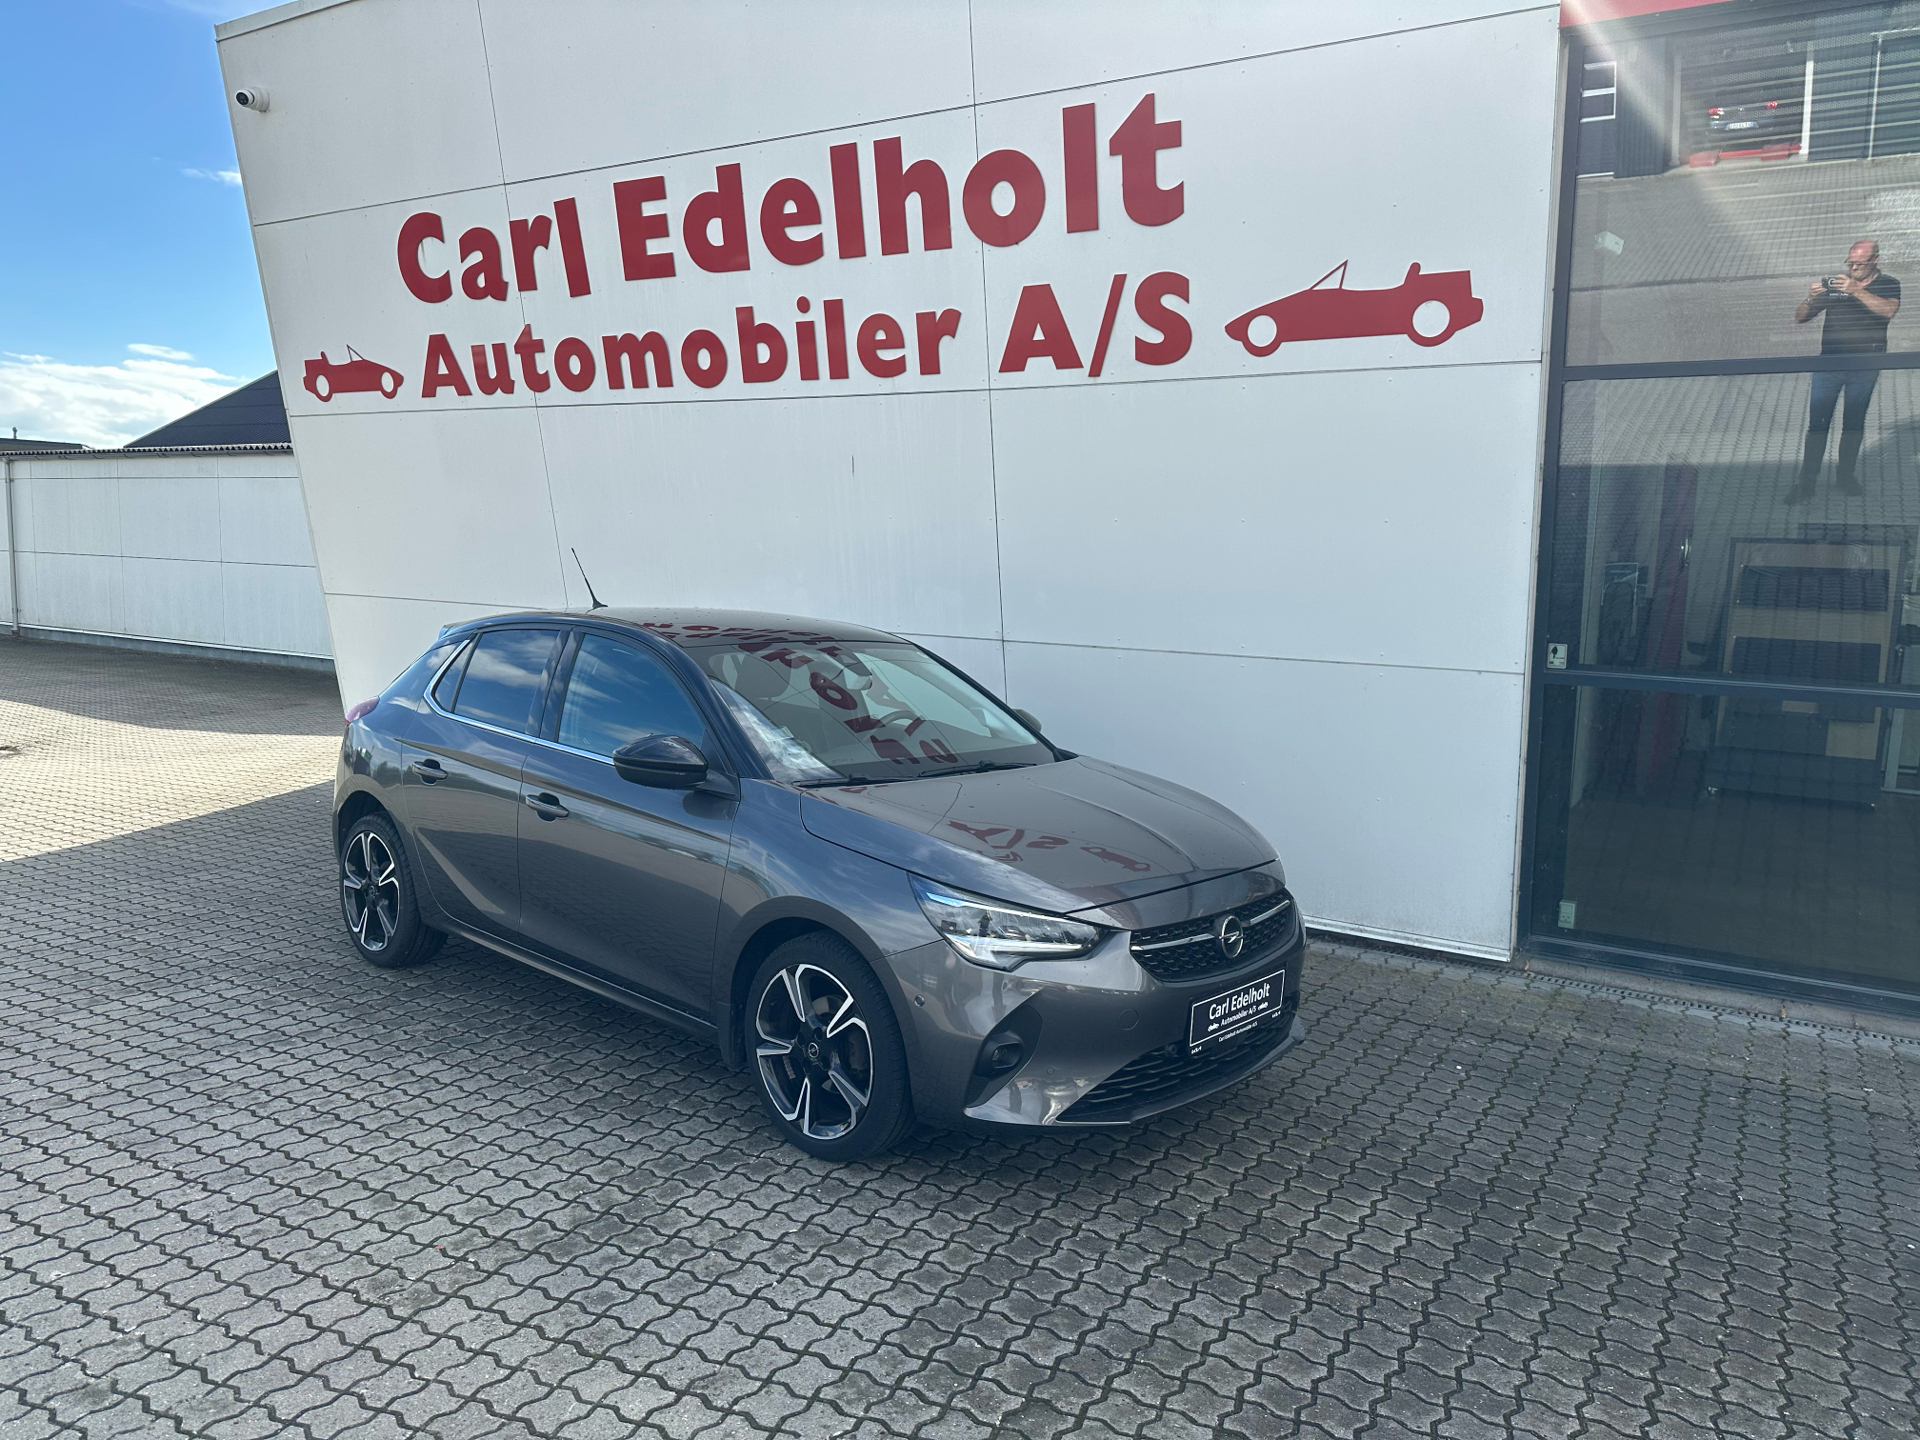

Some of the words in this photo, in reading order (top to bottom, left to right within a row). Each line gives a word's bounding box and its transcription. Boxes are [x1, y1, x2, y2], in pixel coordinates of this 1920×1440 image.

[398, 198, 590, 303] Carl
[613, 92, 1185, 281] Edelholt
[421, 297, 962, 399] Automobiler
[999, 271, 1193, 378] A/S
[1209, 997, 1230, 1020] Carl
[1231, 983, 1270, 1011] Edelholt
